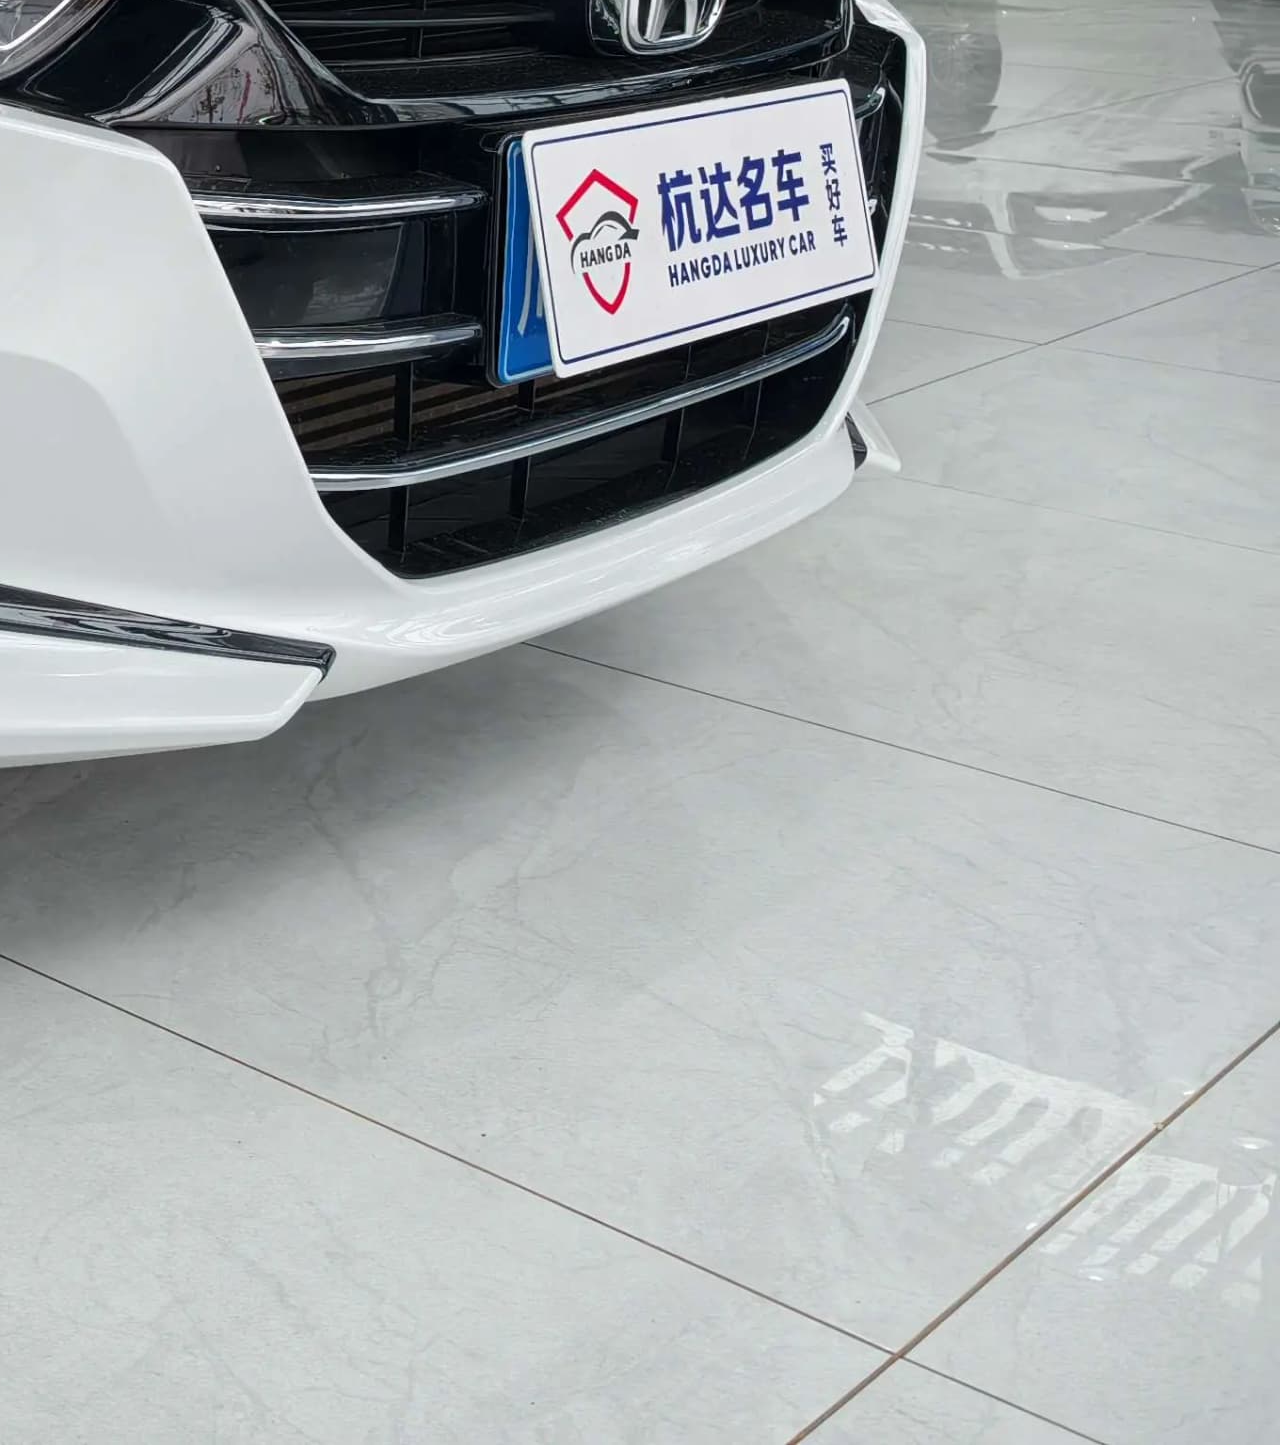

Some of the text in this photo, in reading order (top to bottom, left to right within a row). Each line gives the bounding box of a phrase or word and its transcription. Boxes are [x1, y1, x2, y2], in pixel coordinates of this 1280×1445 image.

[657, 149, 810, 252] 杭达名车
[819, 142, 848, 247] 买好车
[580, 242, 632, 268] HANG DA
[668, 230, 816, 287] HANGDA LUXURY CAR
